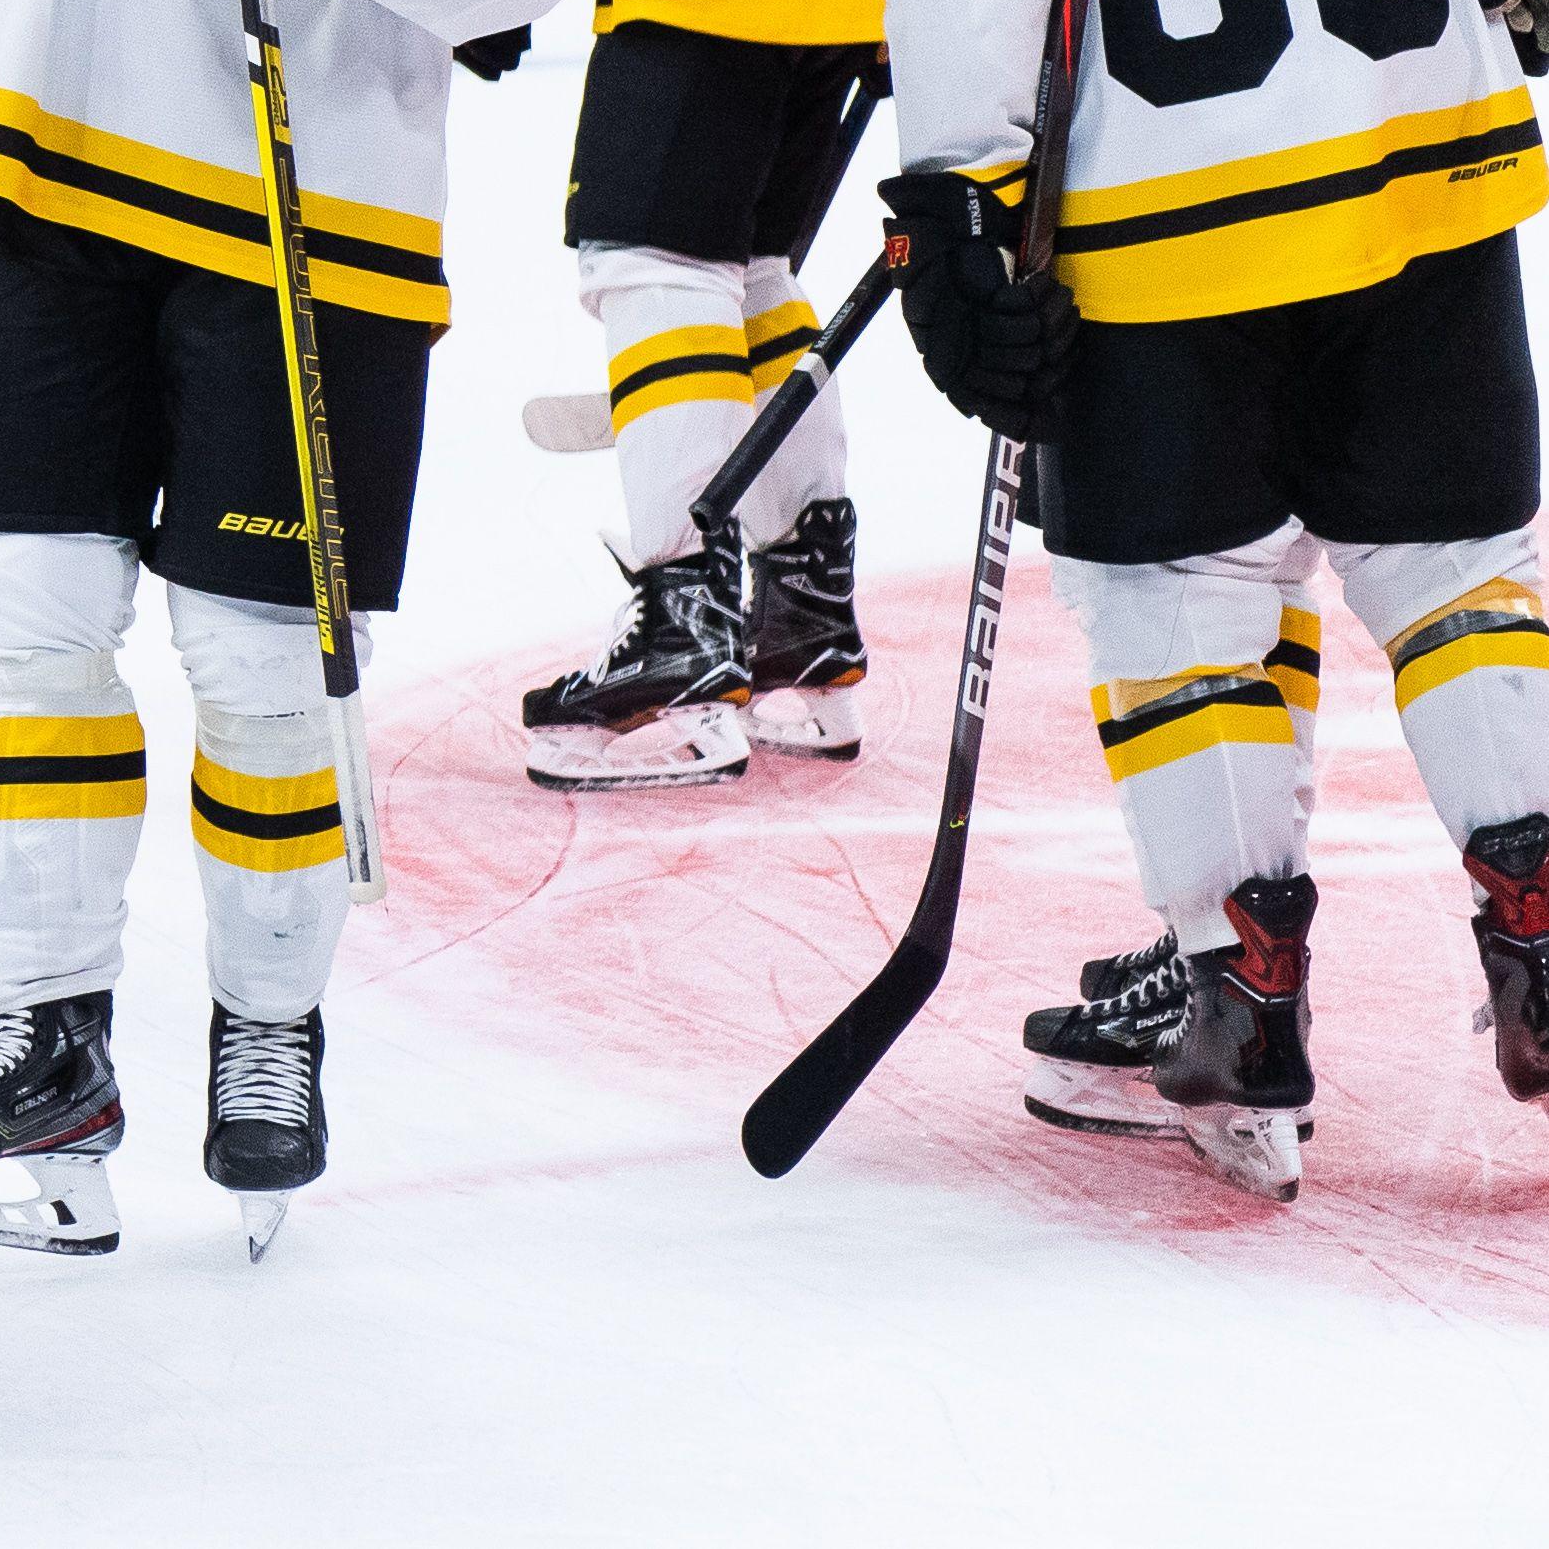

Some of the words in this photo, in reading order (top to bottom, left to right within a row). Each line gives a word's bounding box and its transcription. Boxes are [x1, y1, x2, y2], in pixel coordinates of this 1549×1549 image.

[1447, 157, 1519, 183] BAUER
[218, 512, 314, 542] BAU
[962, 434, 1028, 721] BAUER
